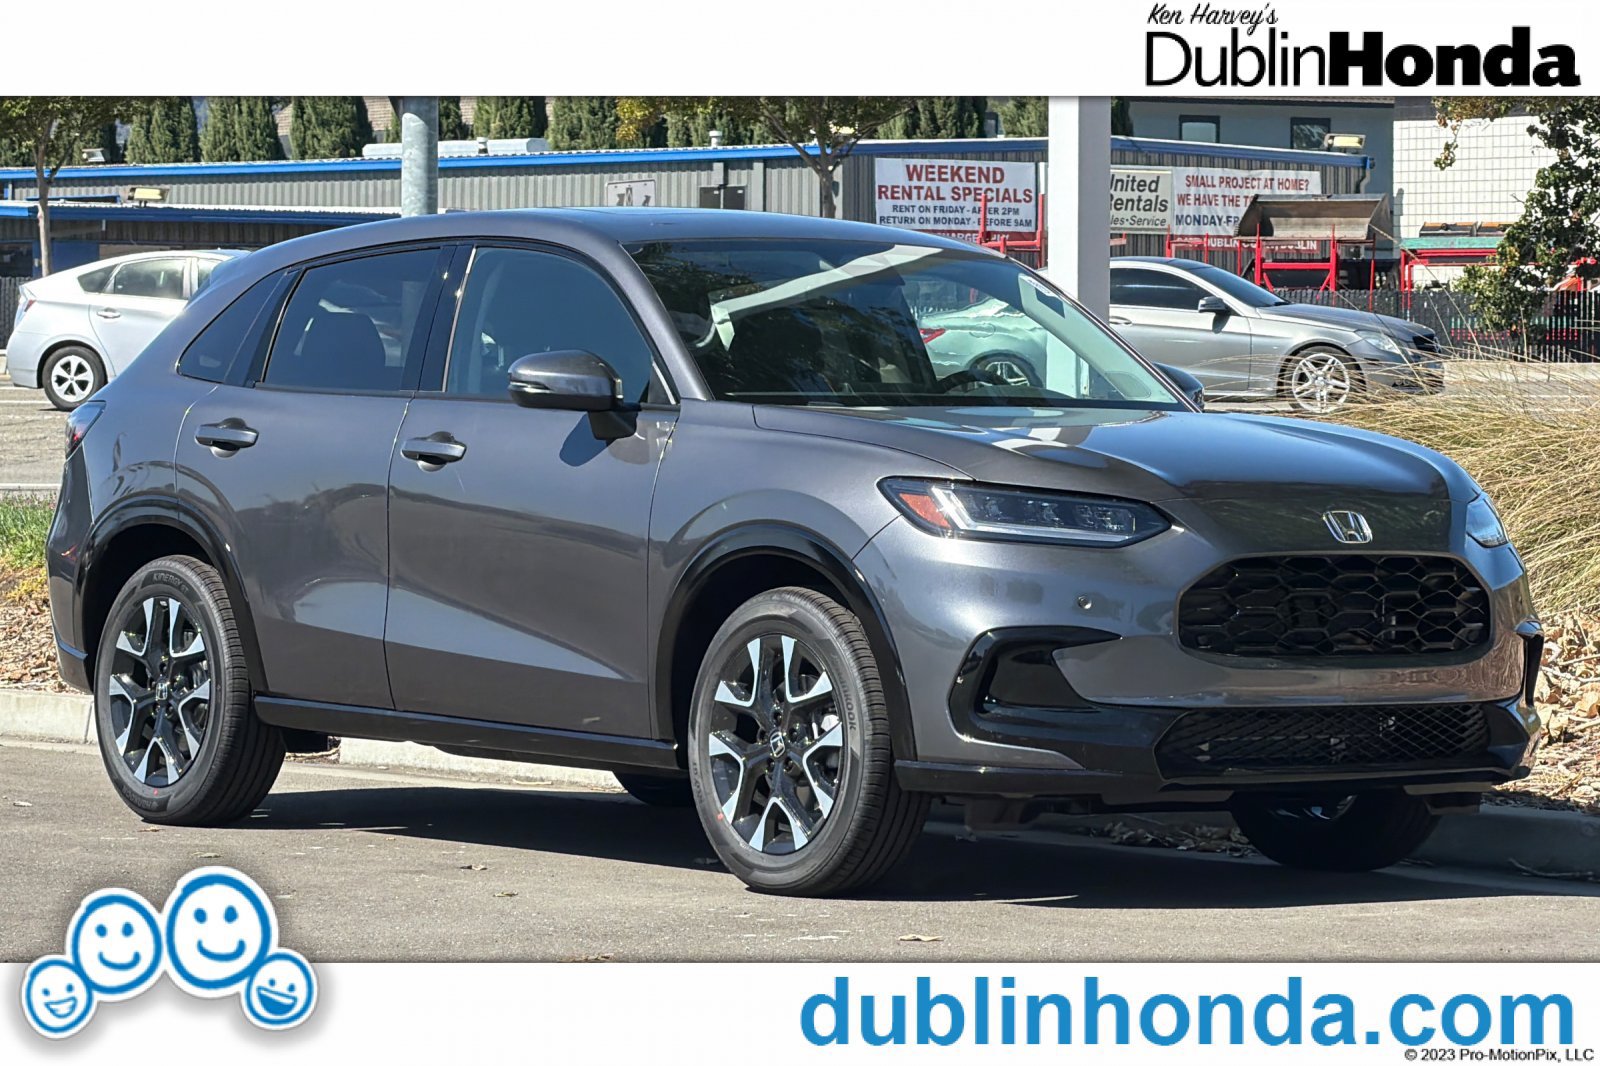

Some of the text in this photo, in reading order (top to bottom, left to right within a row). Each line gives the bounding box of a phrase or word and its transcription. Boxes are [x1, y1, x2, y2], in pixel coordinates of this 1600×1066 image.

[906, 164, 1005, 184] WEEKEND
[1185, 175, 1309, 191] SMALL PROJECT AT HOME?
[878, 185, 1033, 203] RENTAL SPECIALS
[1177, 194, 1192, 206] WE
[1194, 194, 1219, 207] HAVE
[1221, 195, 1240, 208] THE
[892, 205, 915, 214] RENT
[918, 205, 931, 214] ON
[933, 205, 965, 215] FRIDAY
[971, 206, 999, 216] AFER
[1001, 207, 1020, 216] 2PM
[879, 215, 916, 225] RETURN
[918, 216, 931, 225] ON
[933, 216, 971, 226] MONDAY
[1014, 218, 1033, 228] 9AM
